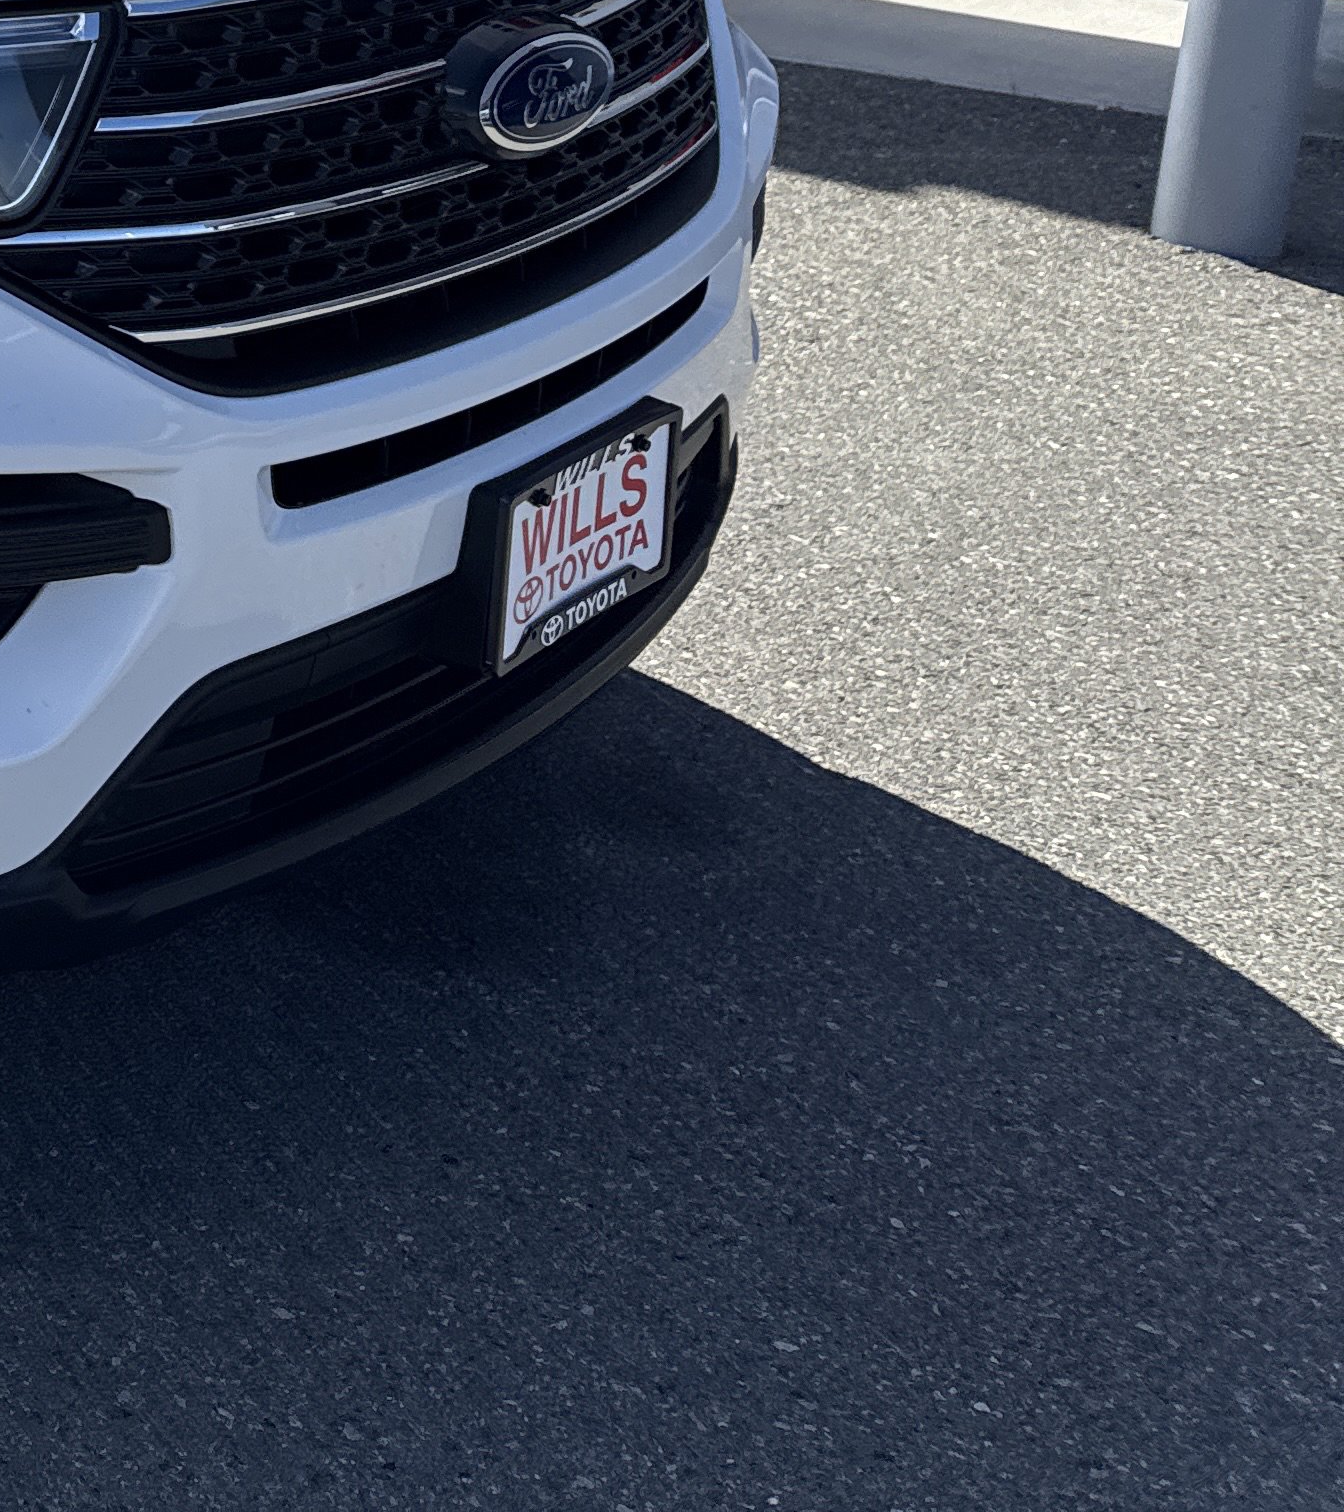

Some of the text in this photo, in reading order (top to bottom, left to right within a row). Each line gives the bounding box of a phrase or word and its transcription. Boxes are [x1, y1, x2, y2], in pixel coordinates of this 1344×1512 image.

[523, 58, 593, 128] Ford
[521, 454, 648, 576] WILLS
[545, 519, 649, 600] TOYOTA
[565, 577, 628, 630] TOYOTA
